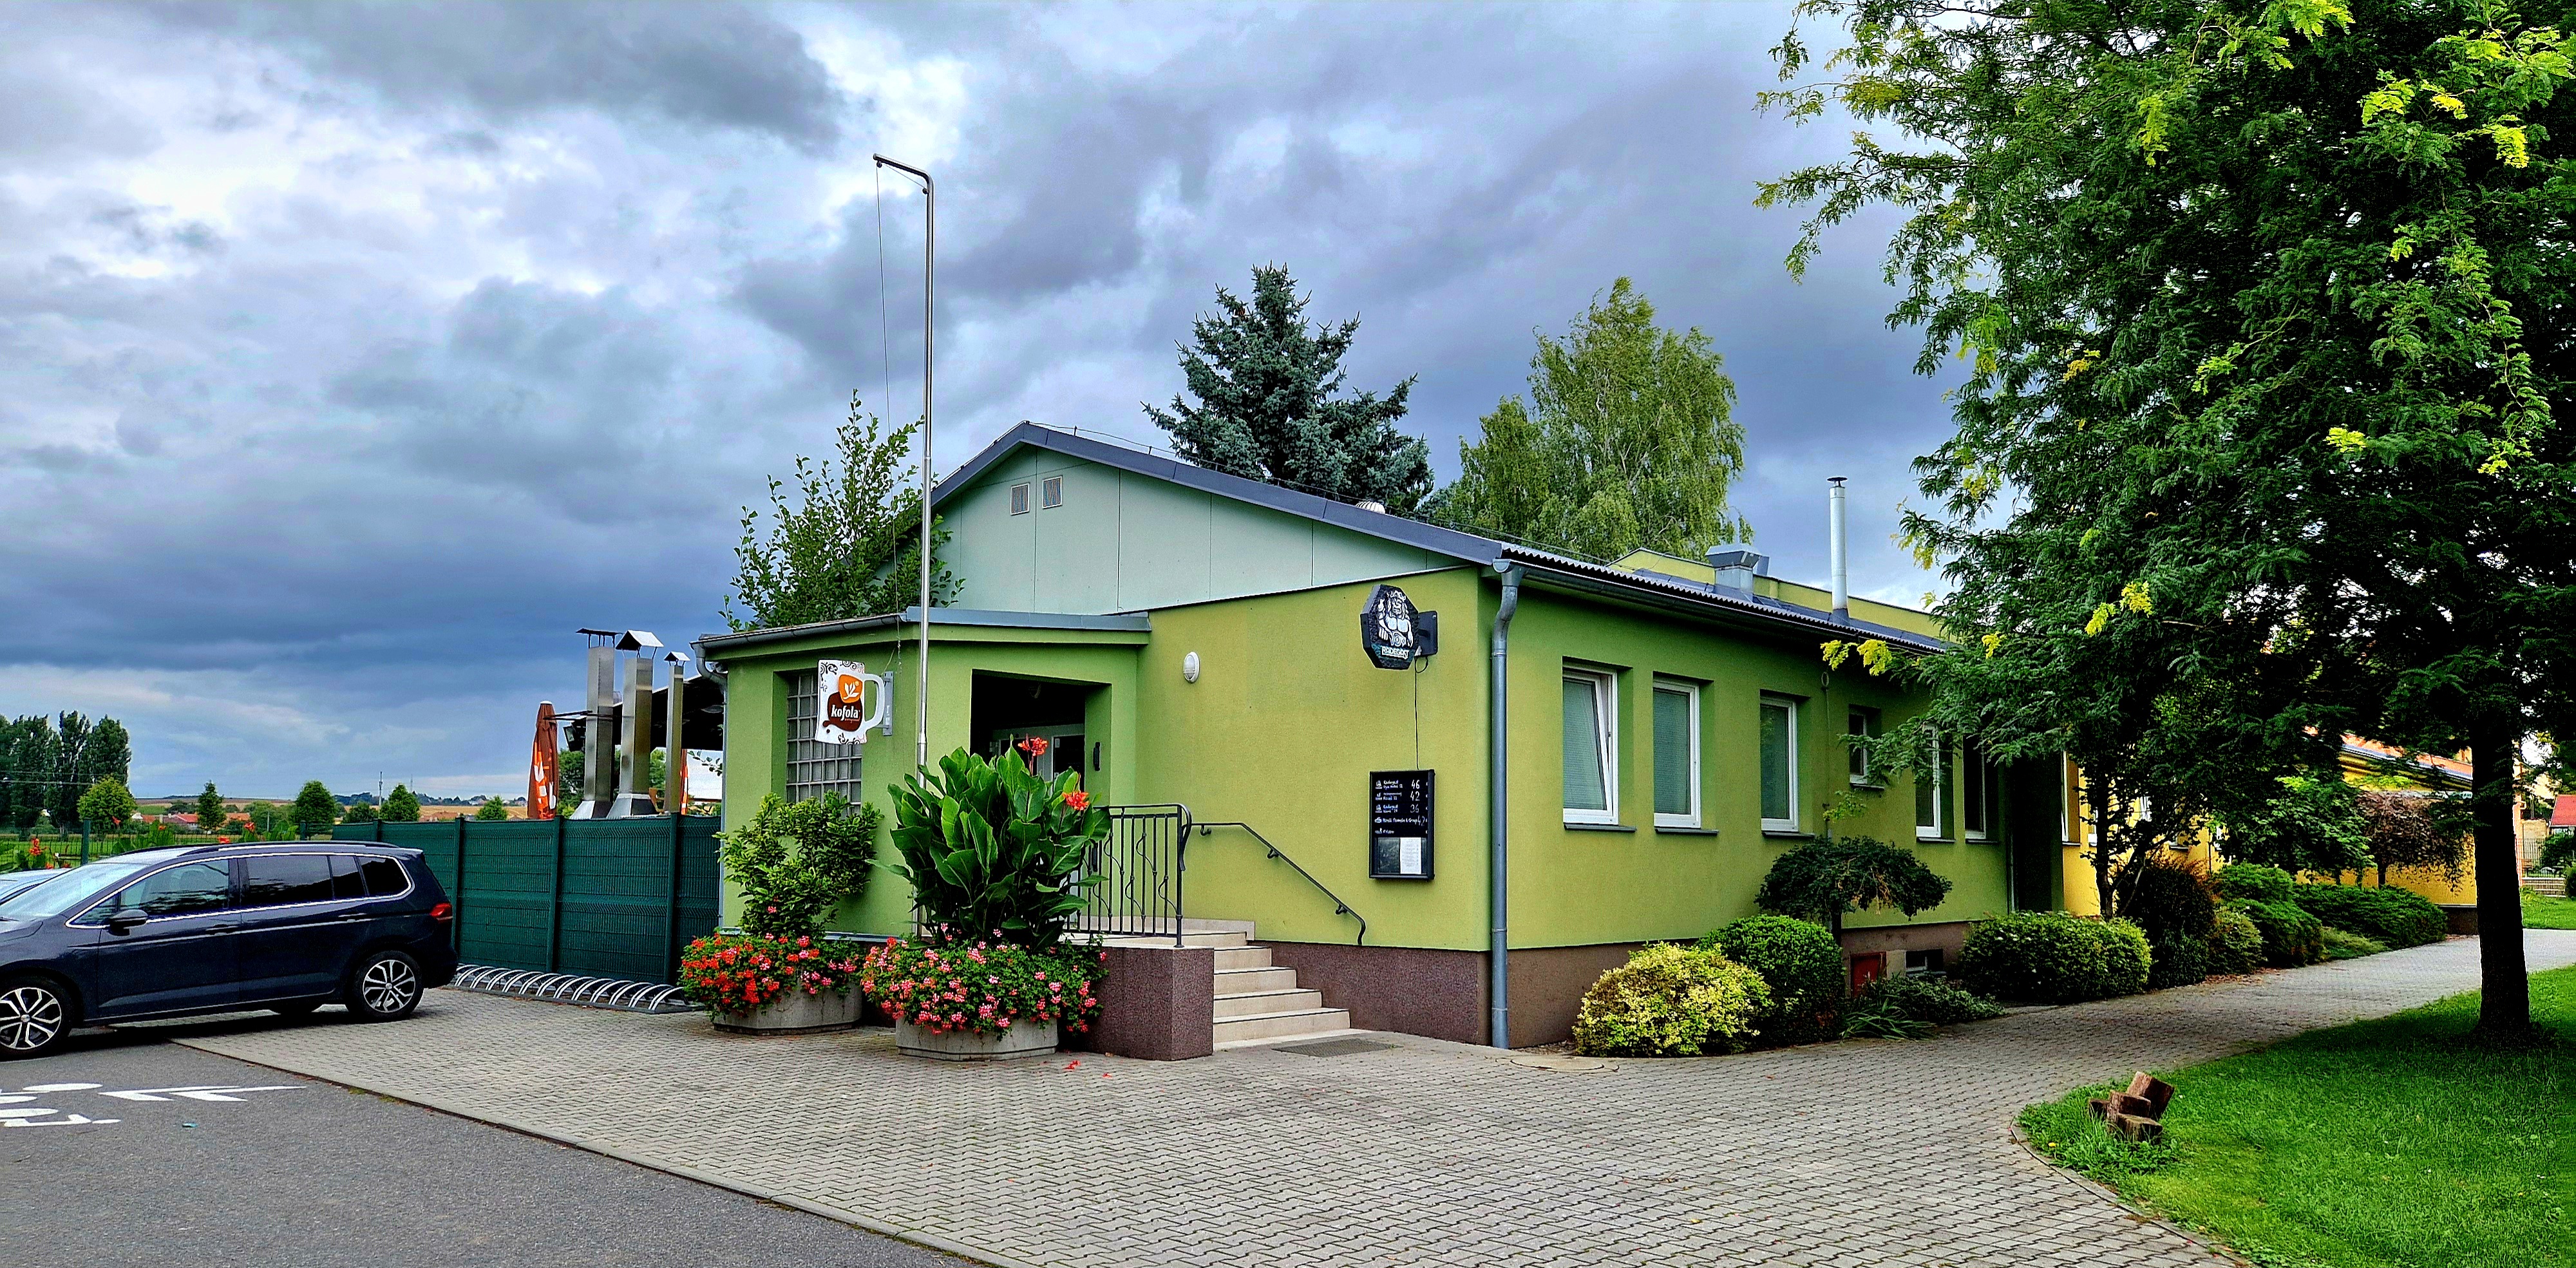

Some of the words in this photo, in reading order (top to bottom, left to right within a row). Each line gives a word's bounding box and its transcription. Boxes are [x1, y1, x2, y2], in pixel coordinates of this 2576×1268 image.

[1382, 646, 1410, 659] RADEGAST
[831, 705, 858, 721] kofola
[1411, 779, 1420, 789] 46
[1410, 791, 1420, 801] 42
[1410, 804, 1419, 813] 36
